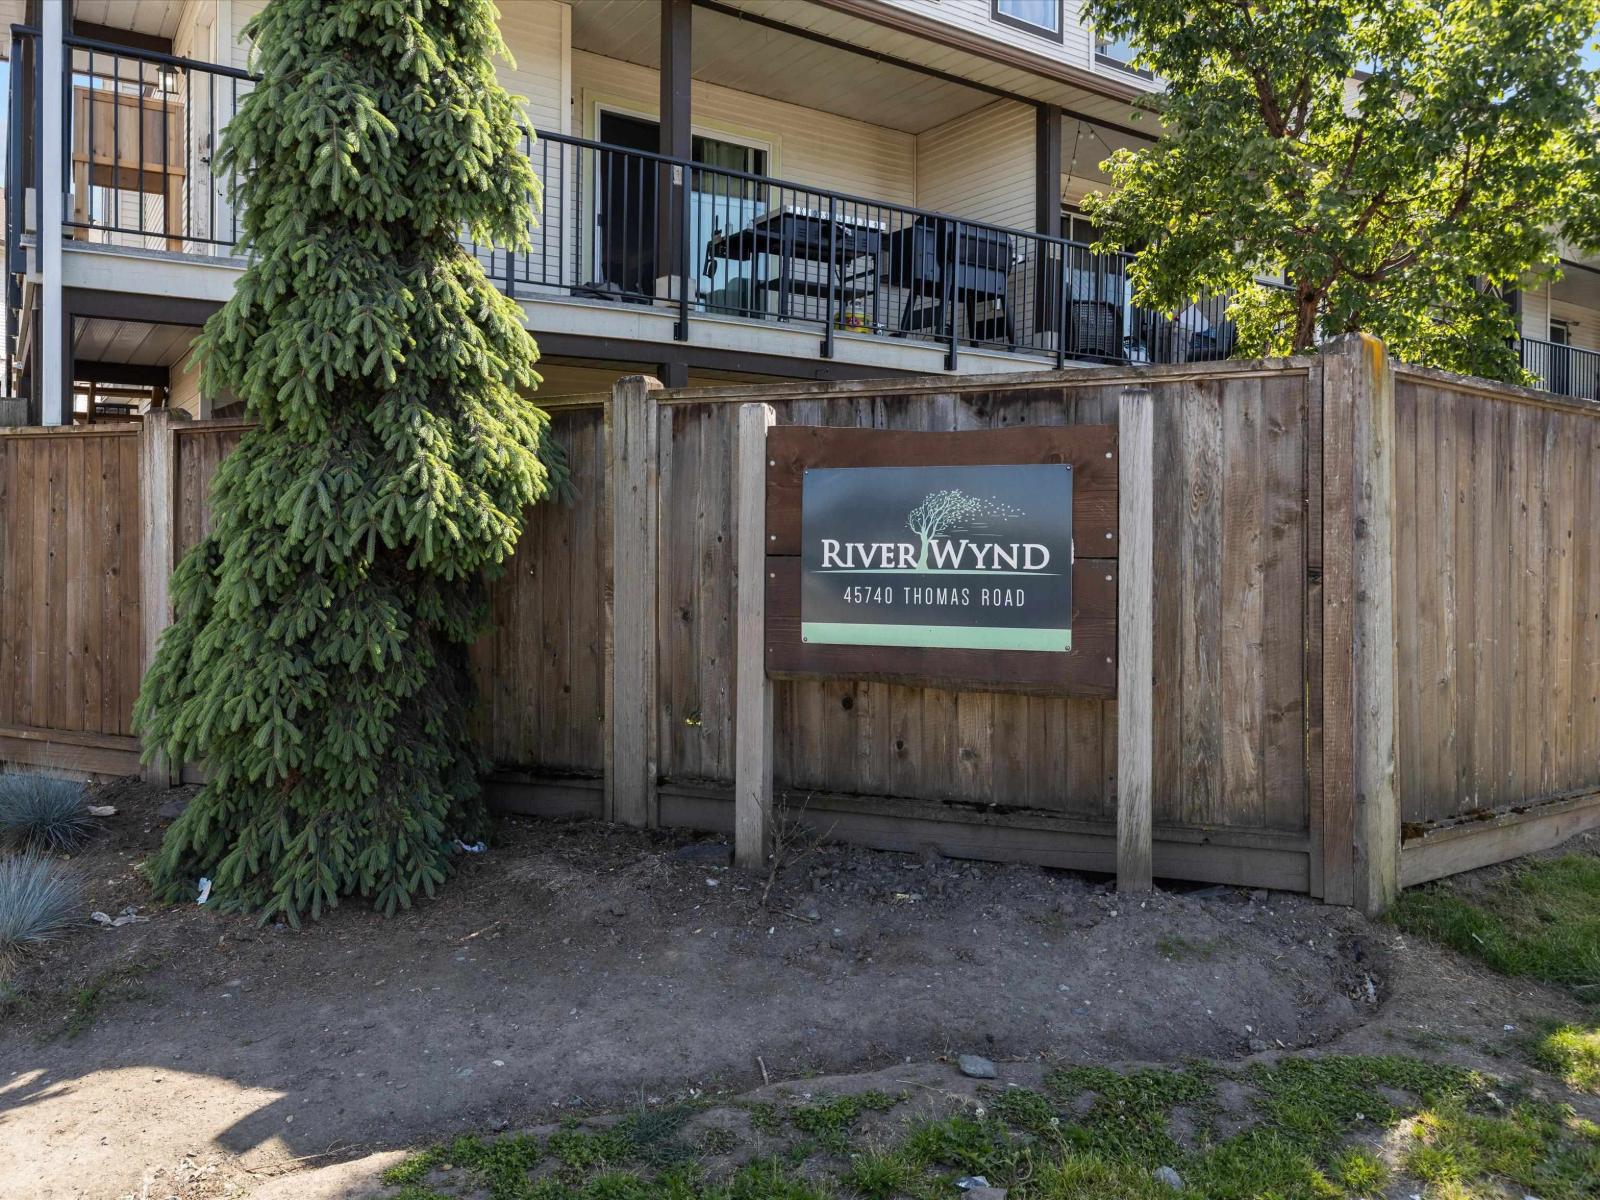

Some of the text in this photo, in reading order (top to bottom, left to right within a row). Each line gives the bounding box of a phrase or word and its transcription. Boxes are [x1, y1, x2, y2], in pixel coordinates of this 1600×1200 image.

[821, 539, 1050, 570] RIVER WYND
[843, 586, 1025, 607] 45740 THOMAS ROAD
